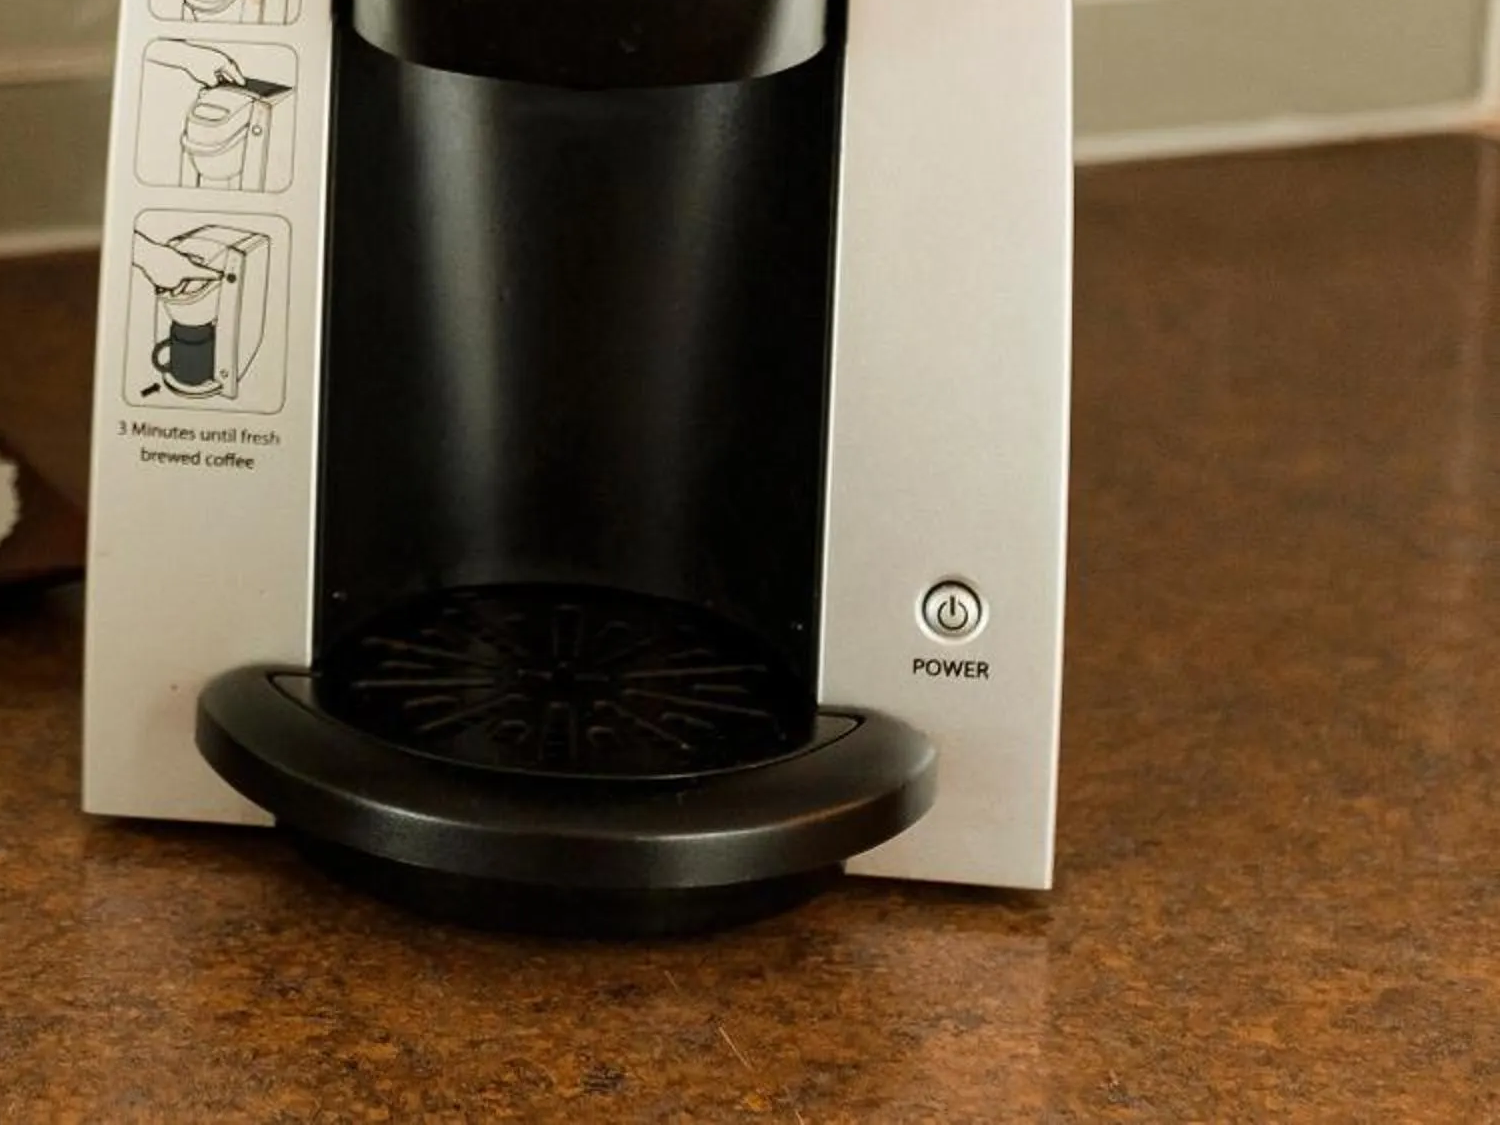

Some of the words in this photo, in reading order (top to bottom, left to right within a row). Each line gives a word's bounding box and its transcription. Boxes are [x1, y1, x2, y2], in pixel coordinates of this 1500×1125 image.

[117, 420, 128, 436] 3
[131, 422, 197, 442] Minutes
[200, 427, 237, 443] until
[241, 428, 281, 446] fresh
[140, 447, 201, 466] brewed
[205, 452, 255, 470] coffee
[912, 658, 990, 680] POWER
